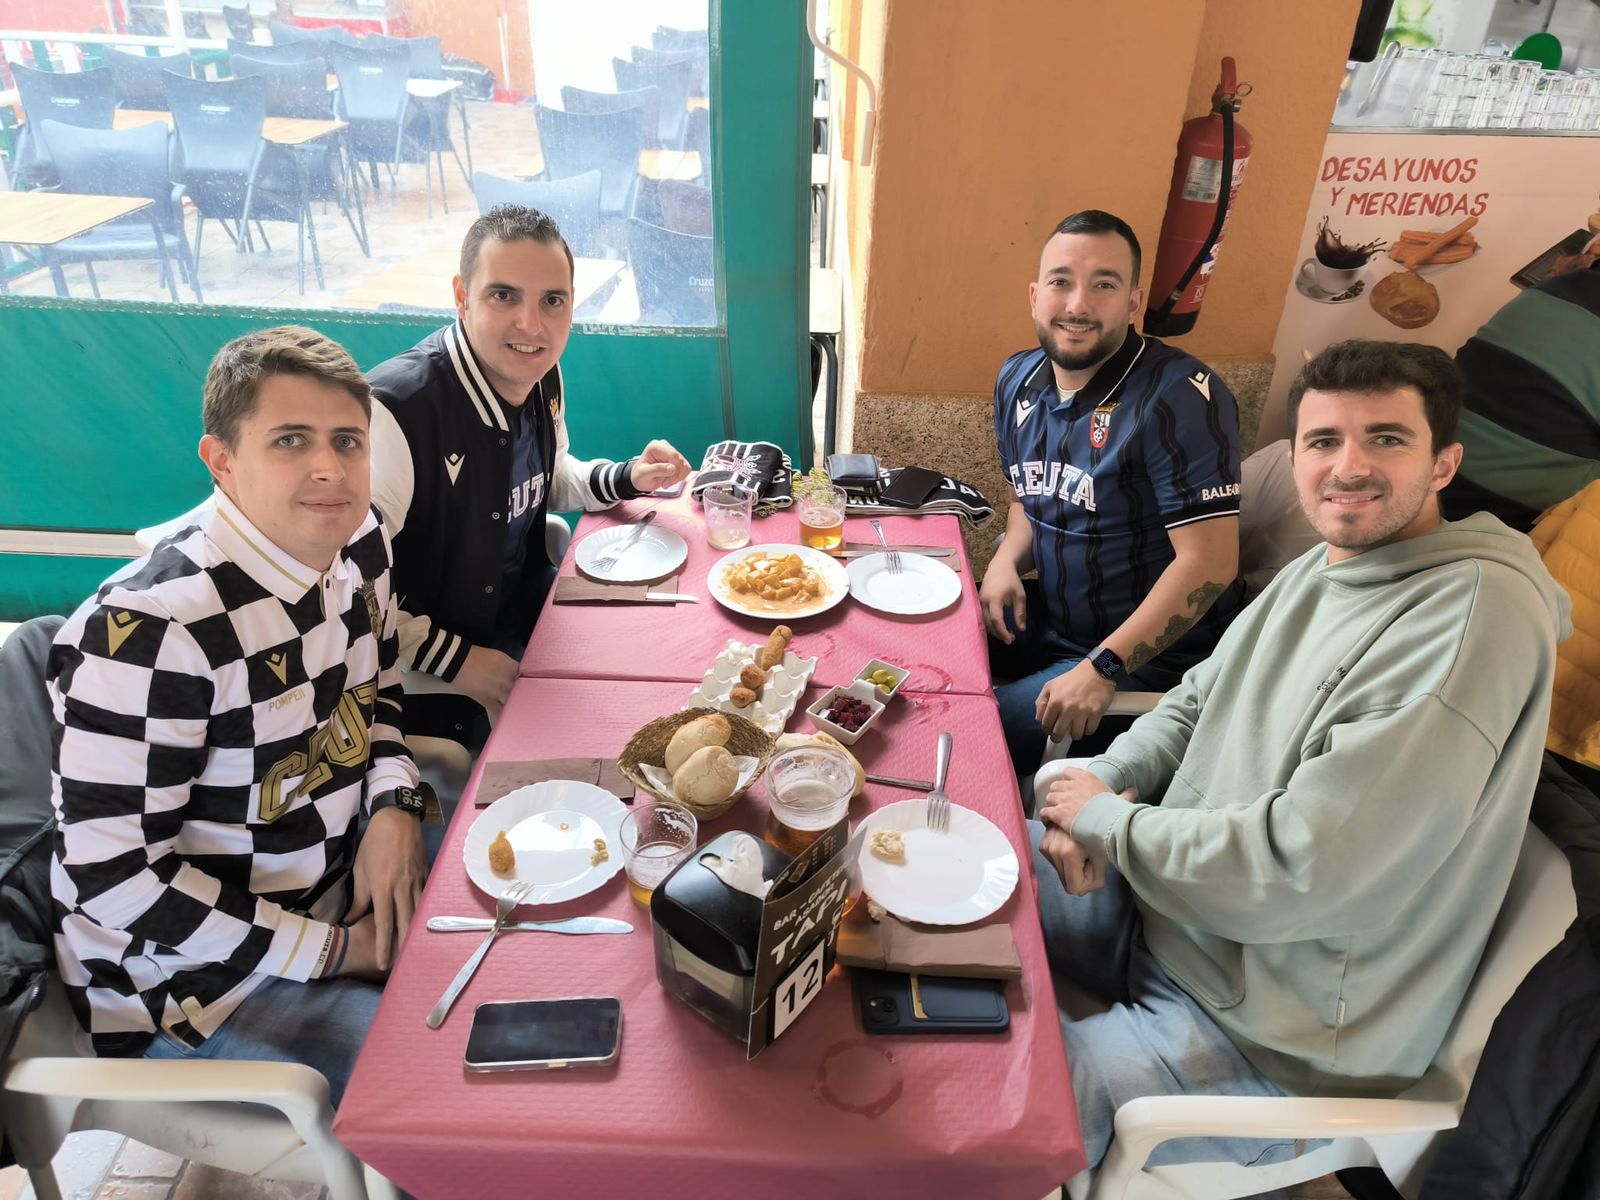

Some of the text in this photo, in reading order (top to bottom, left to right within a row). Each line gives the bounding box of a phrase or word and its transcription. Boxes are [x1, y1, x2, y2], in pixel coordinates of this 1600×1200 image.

[1321, 156, 1479, 183] DESAYUNOS
[1331, 187, 1489, 217] Y MERIENDAS
[1009, 461, 1096, 512] CEUTA
[268, 688, 306, 712] POMPEII
[401, 788, 413, 806] 06
[412, 794, 423, 808] 14
[773, 909, 797, 931] BAR
[782, 958, 819, 1014] 12
